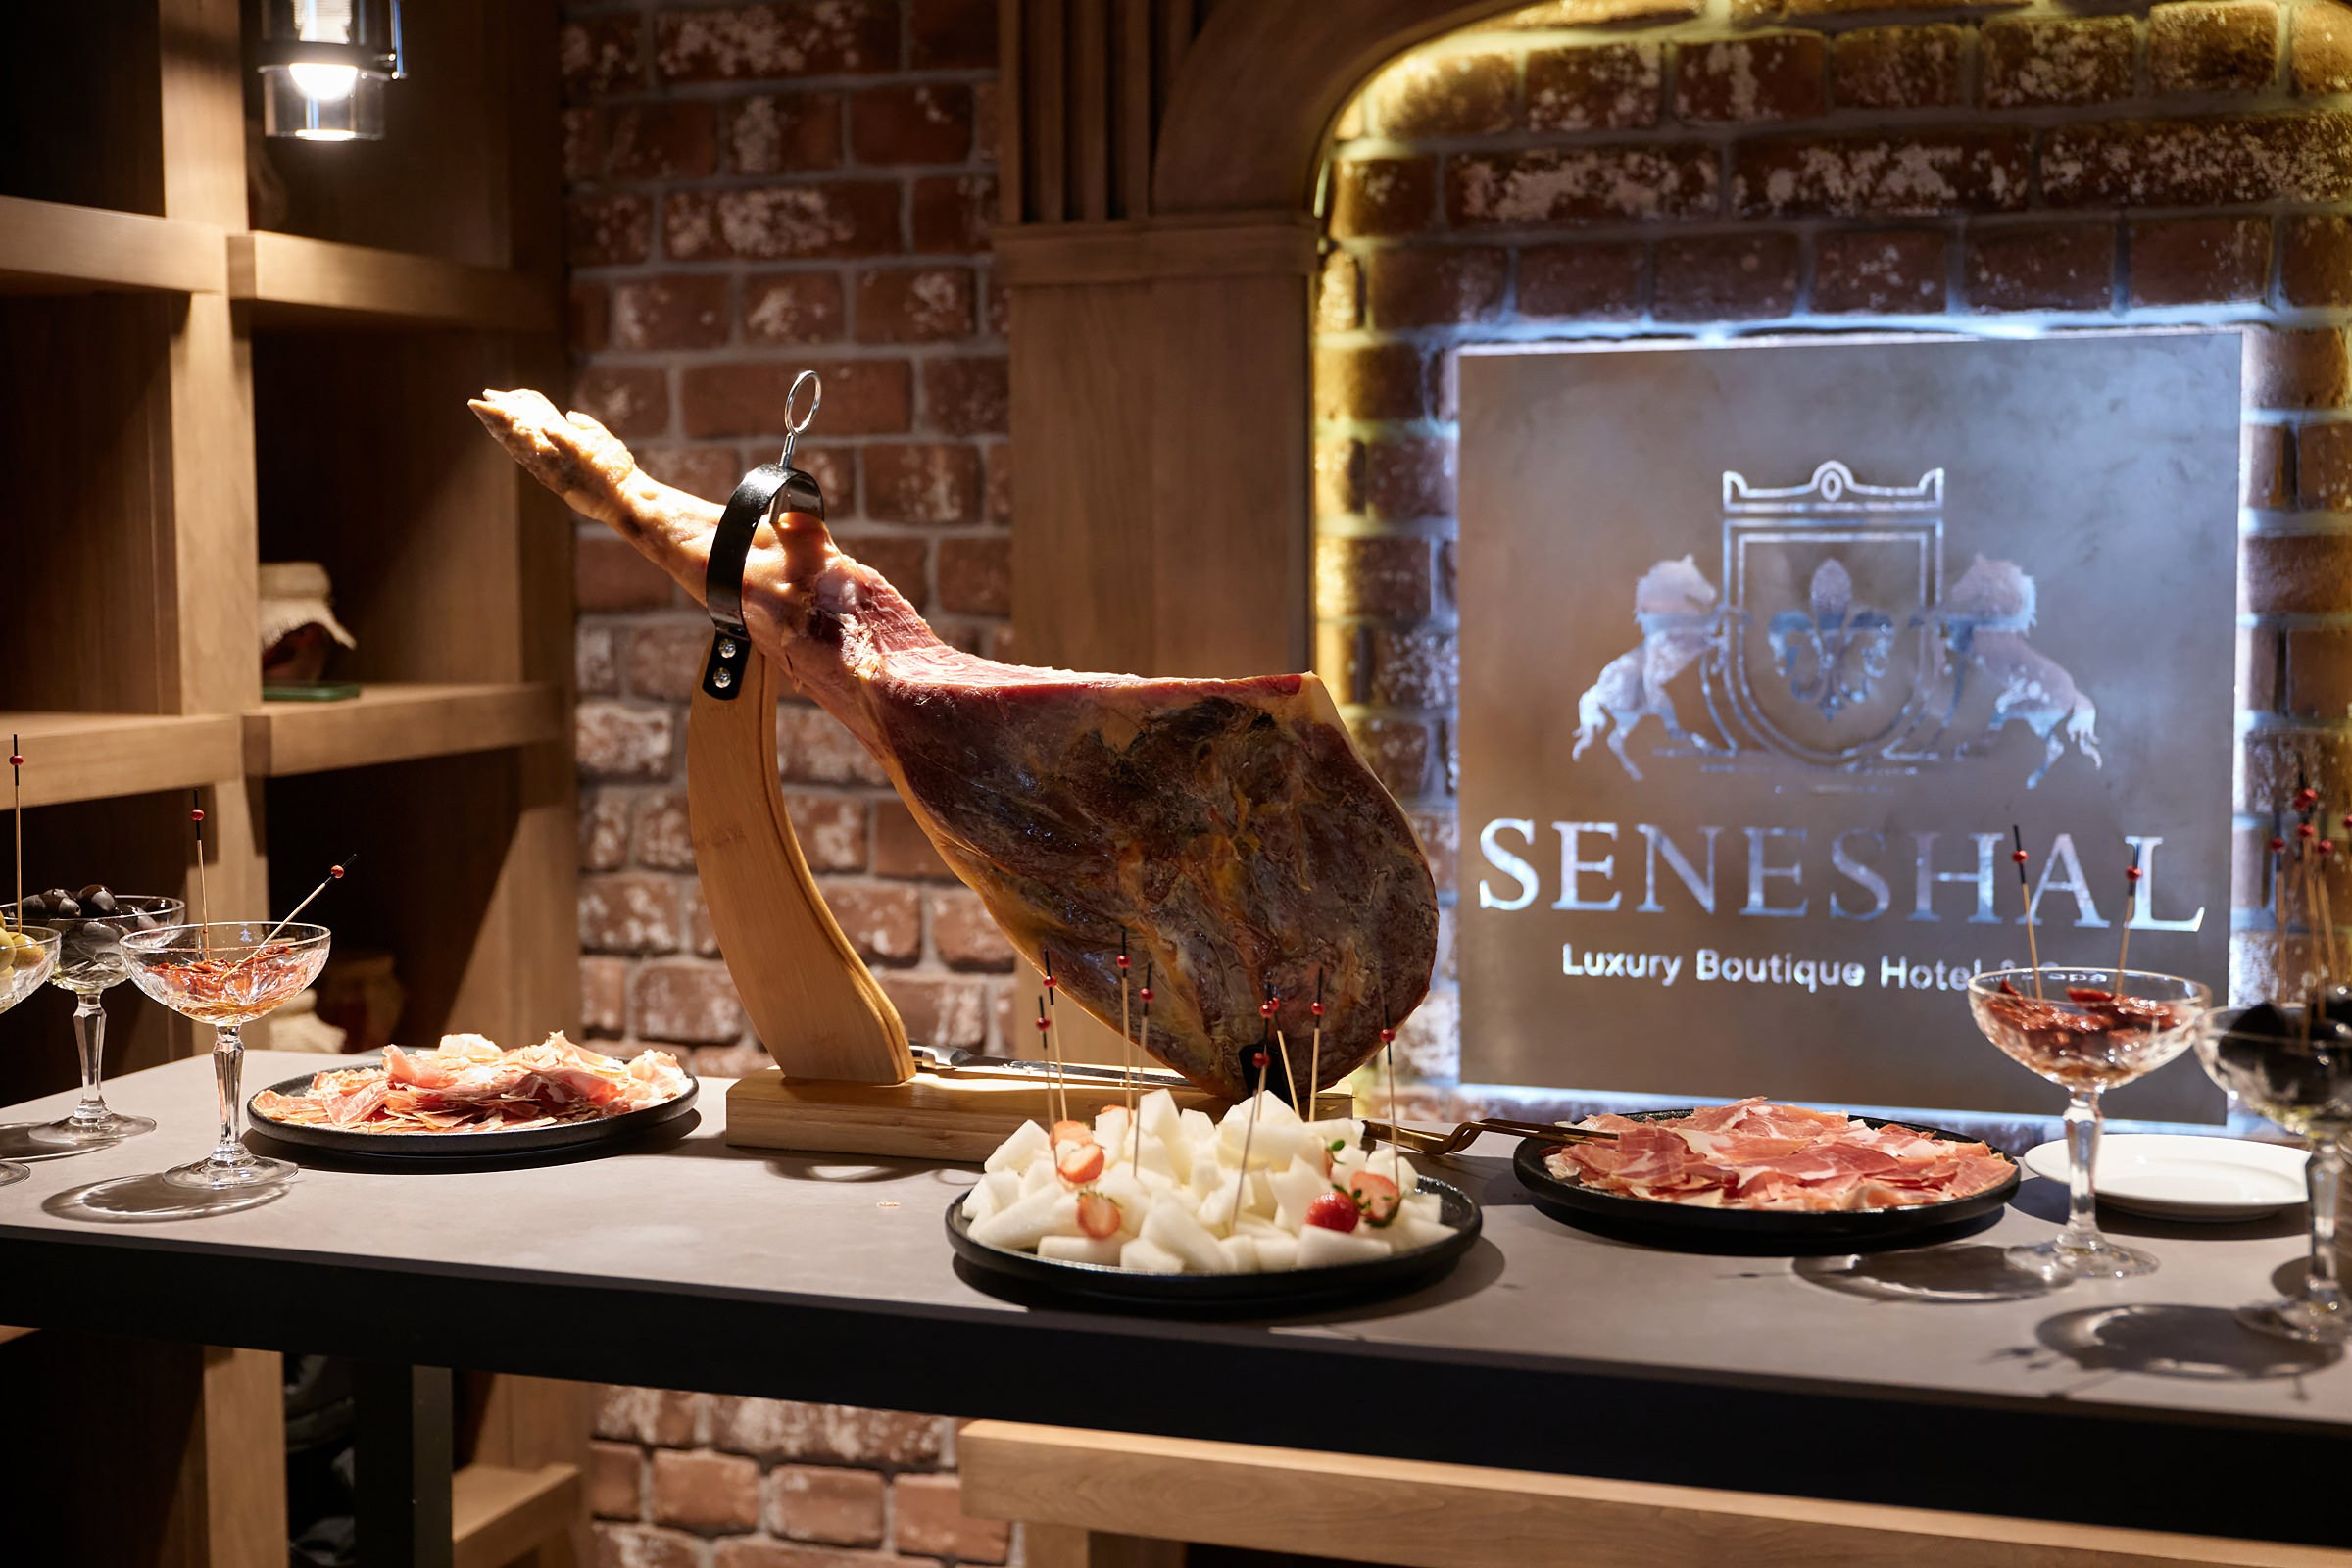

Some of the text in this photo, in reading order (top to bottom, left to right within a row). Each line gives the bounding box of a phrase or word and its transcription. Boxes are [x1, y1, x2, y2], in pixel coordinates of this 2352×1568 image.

[1478, 817, 2205, 932] SENESHAL
[1562, 943, 1683, 987] Luxury
[1696, 948, 1866, 993] Boutique
